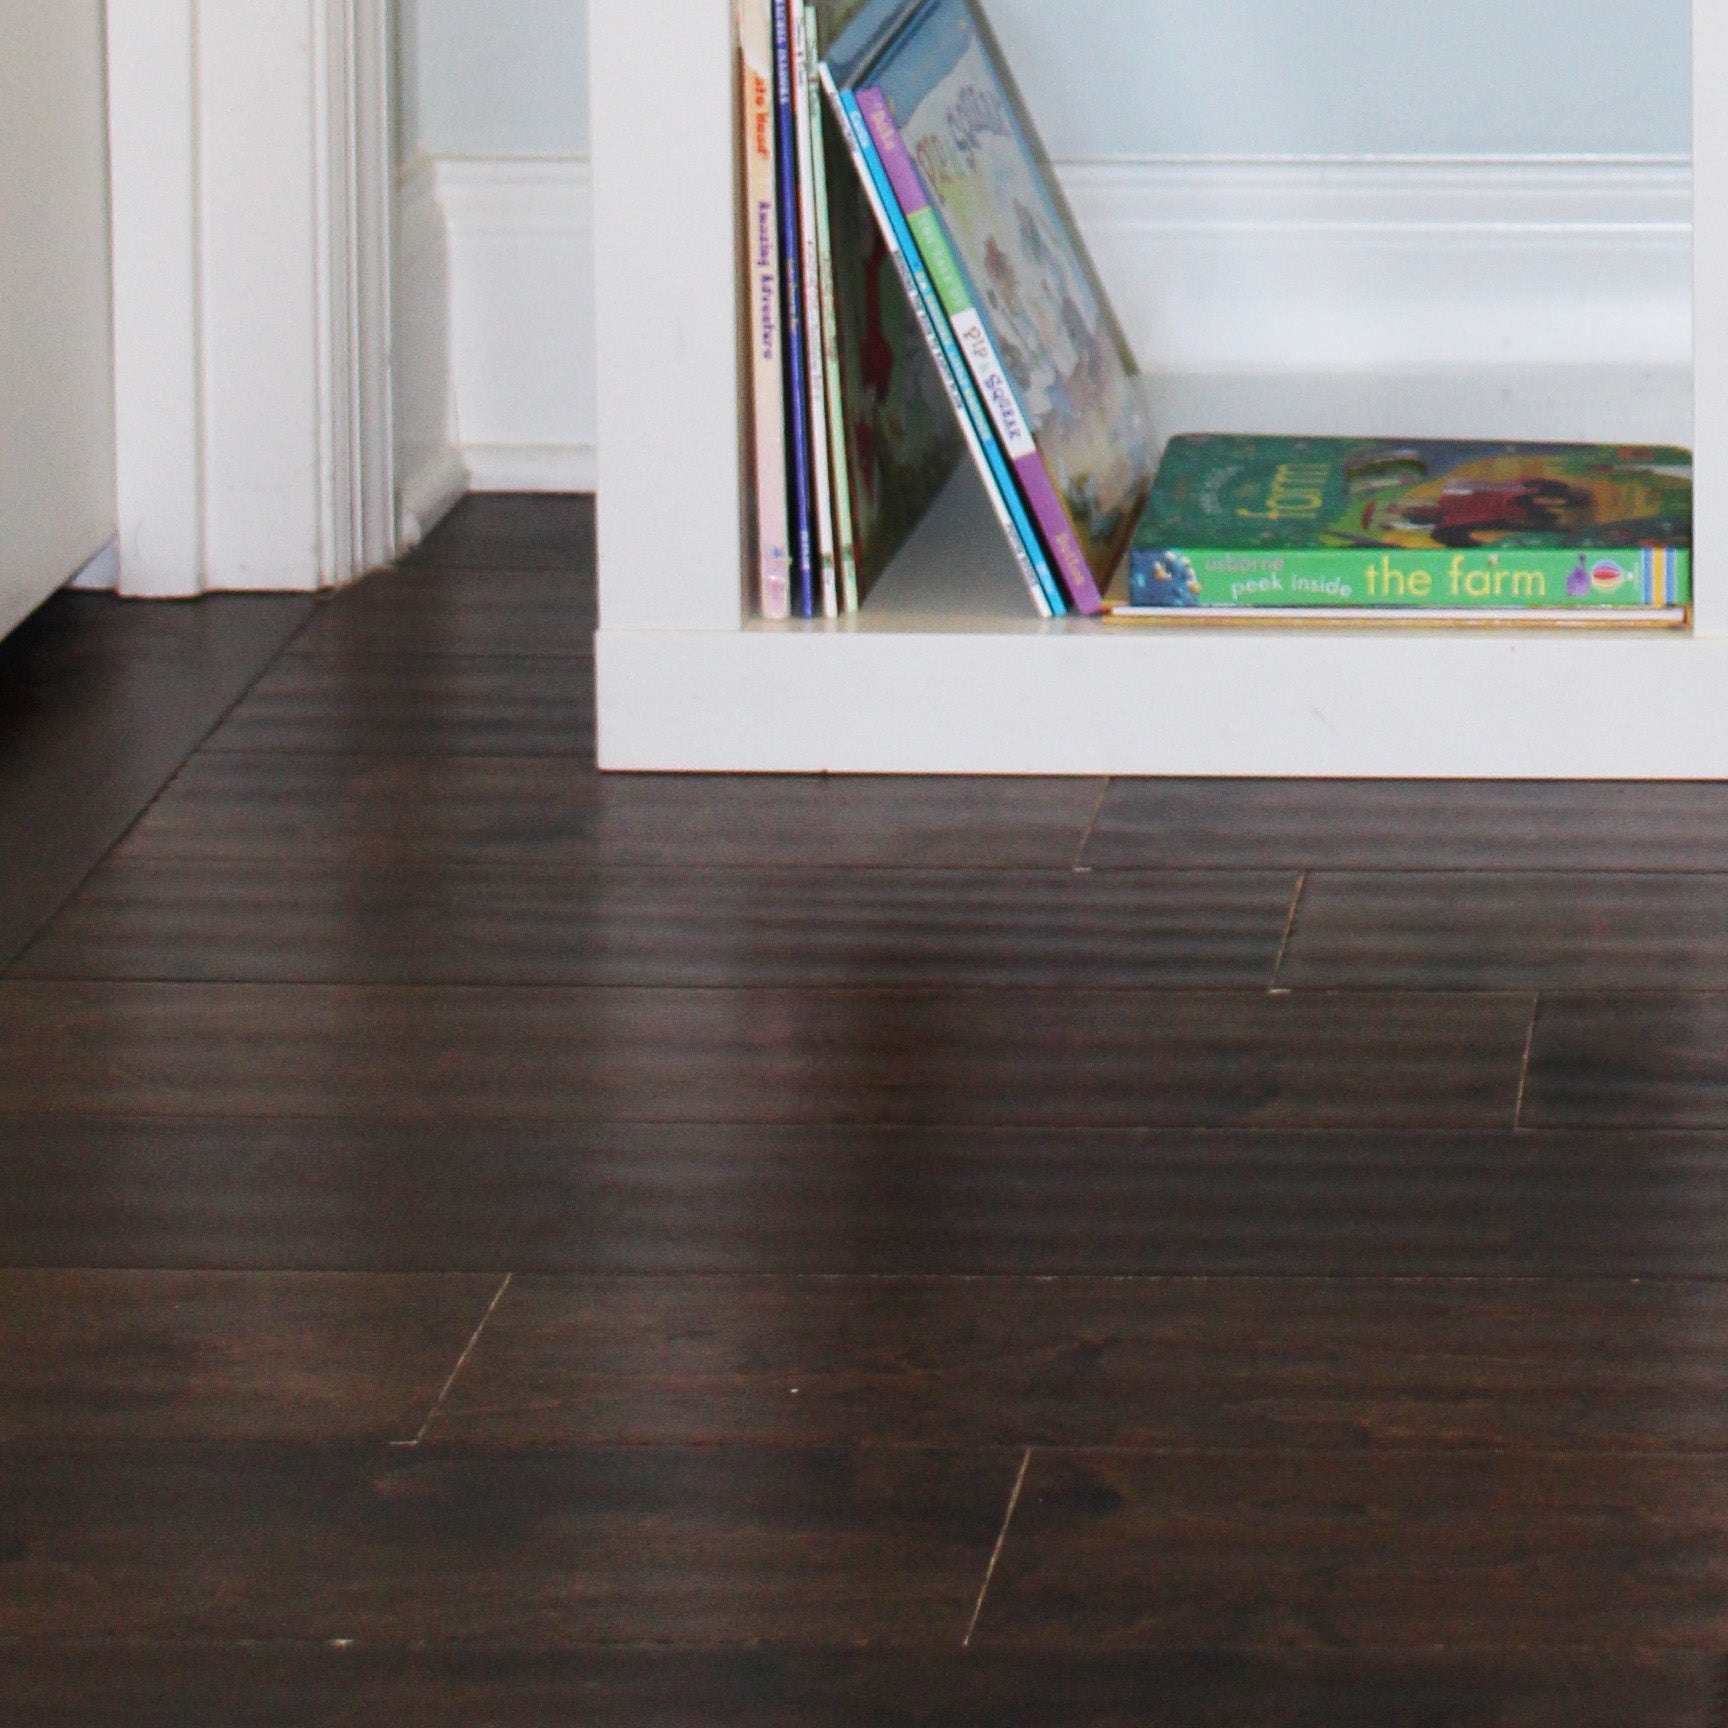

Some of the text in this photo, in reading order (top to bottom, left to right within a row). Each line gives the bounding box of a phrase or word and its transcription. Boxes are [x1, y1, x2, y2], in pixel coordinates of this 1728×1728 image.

[757, 201, 771, 266] Amazing
[1205, 552, 1285, 572] usborne
[1231, 554, 1546, 600] peek inside the farm
